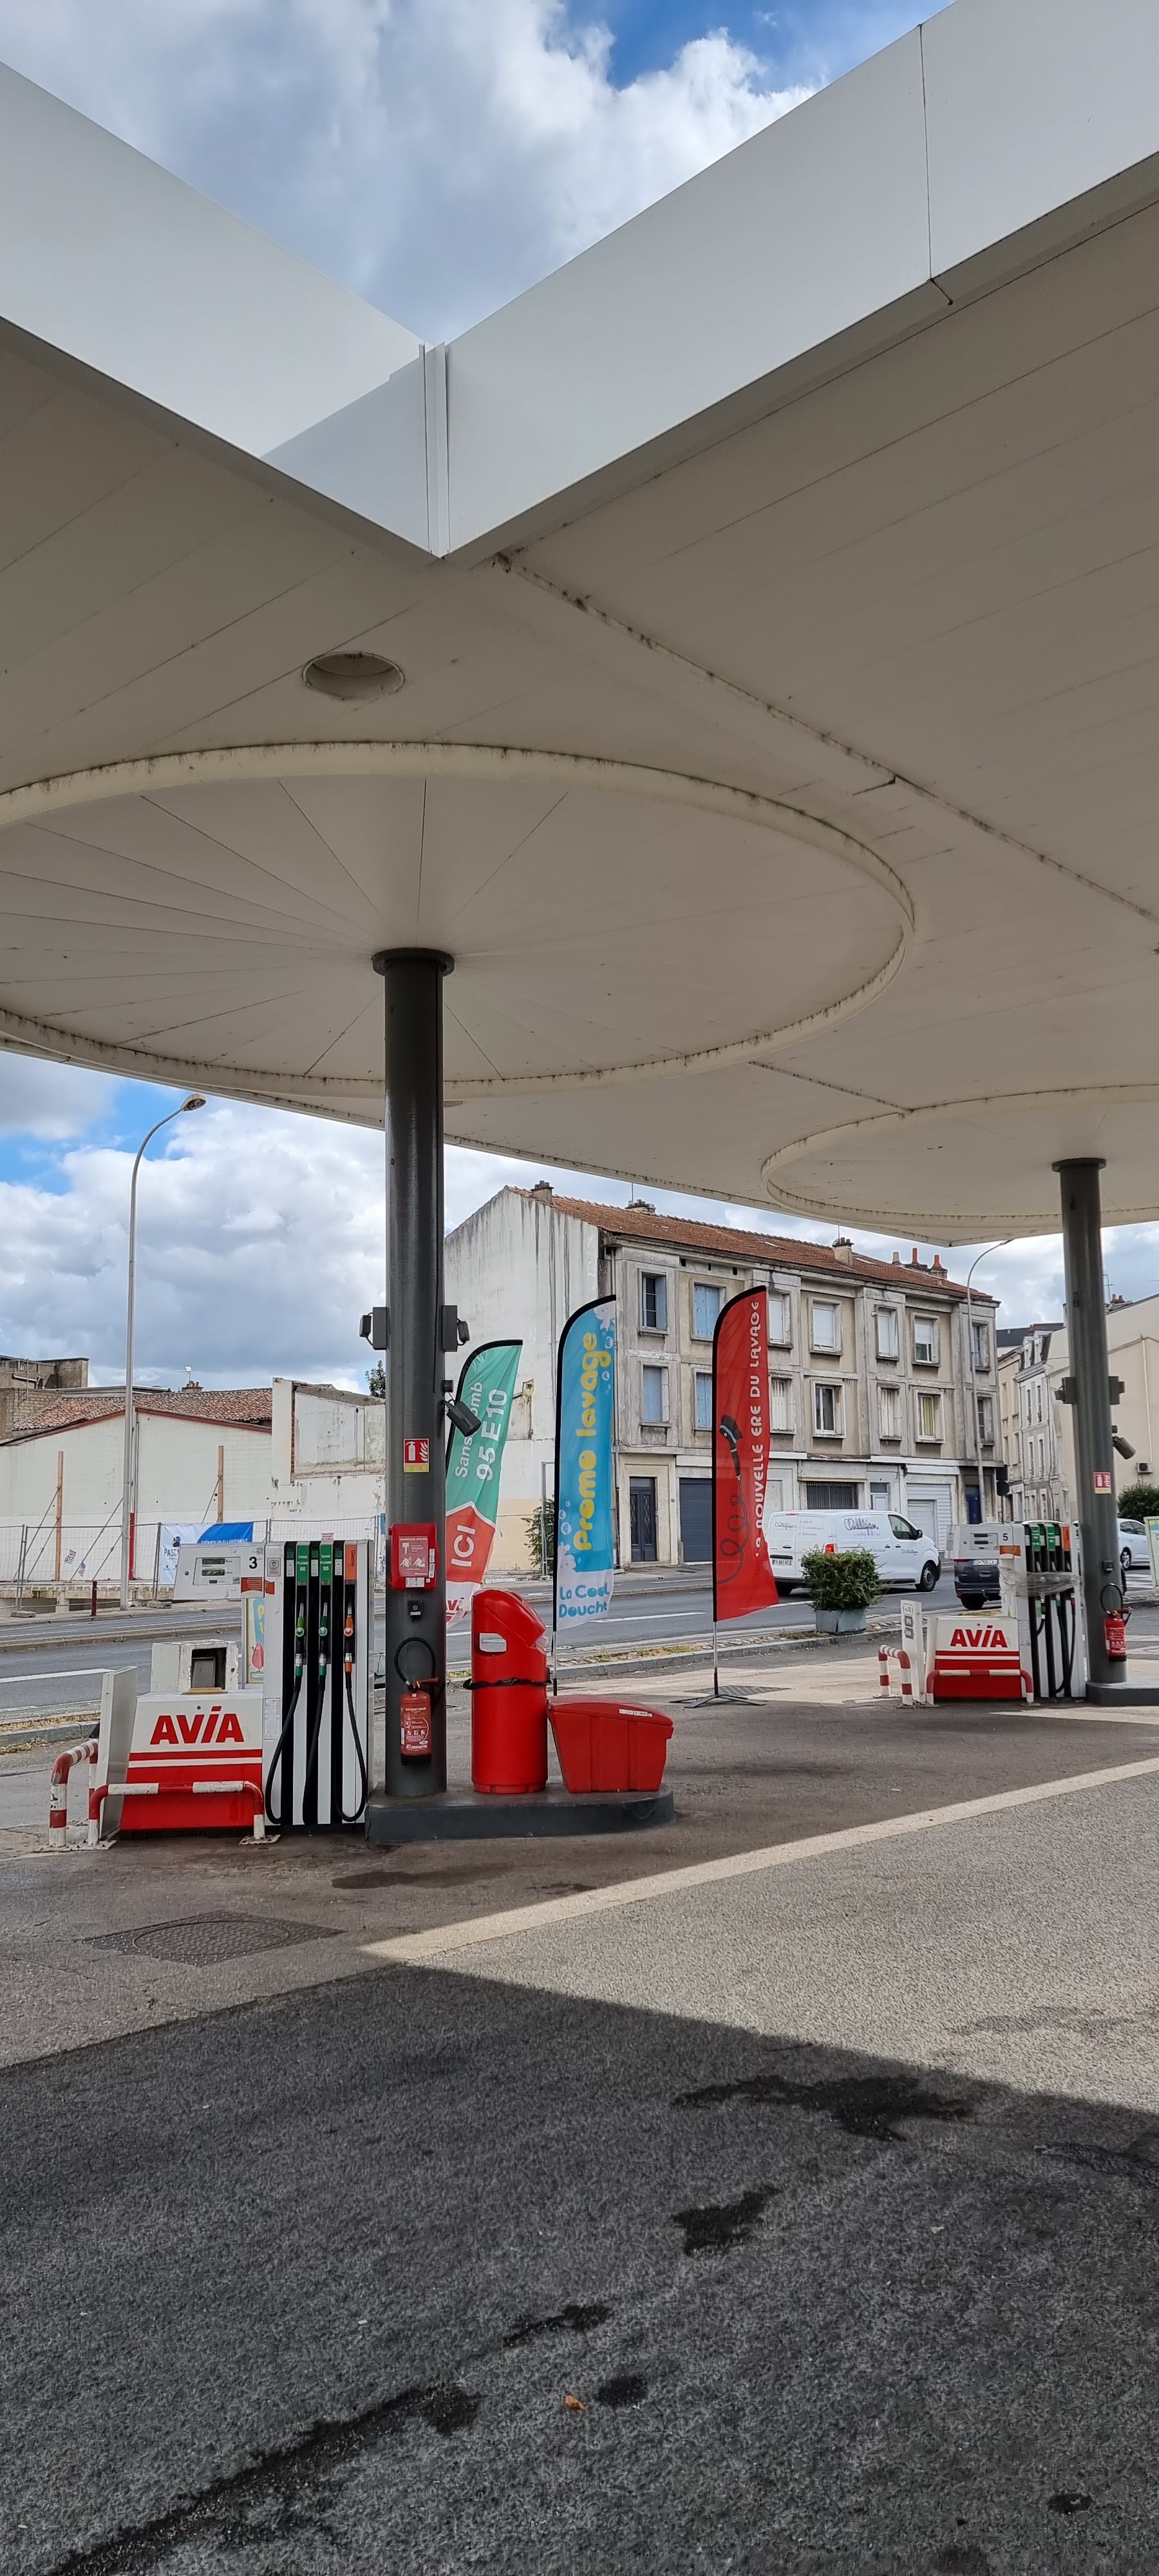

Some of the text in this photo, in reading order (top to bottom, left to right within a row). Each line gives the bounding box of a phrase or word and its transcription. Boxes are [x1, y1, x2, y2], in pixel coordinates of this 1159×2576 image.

[749, 1302, 761, 1368] LAVAGE
[750, 1375, 761, 1397] DU
[476, 1389, 507, 1481] 95 E10
[573, 1332, 611, 1551] Promo lavage
[750, 1405, 762, 1437] ERE
[455, 1435, 473, 1478] Sans
[751, 1444, 764, 1529] NOUVELLE
[450, 1524, 476, 1567] ICI
[843, 1518, 880, 1536] Culligan
[249, 1557, 258, 1569] 3
[559, 1585, 572, 1601] La
